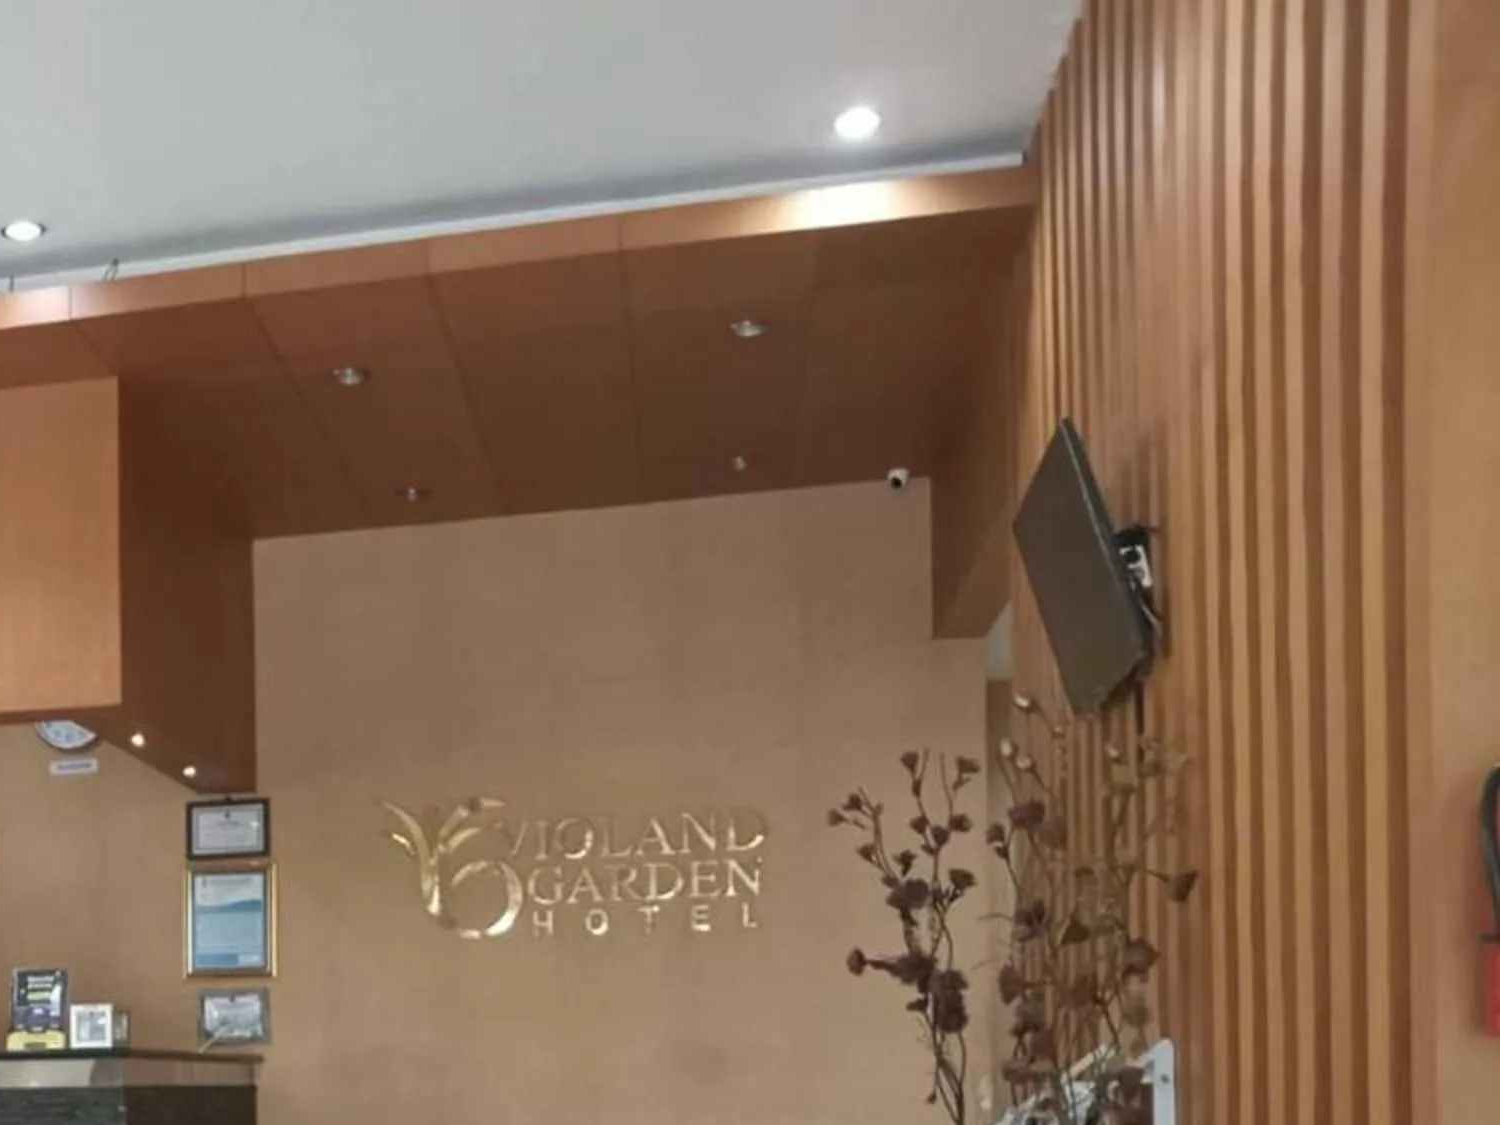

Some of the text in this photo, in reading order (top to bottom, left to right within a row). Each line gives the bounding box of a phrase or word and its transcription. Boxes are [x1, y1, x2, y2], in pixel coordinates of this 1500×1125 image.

[495, 811, 767, 861] VIOLAND
[527, 857, 761, 904] GARDEN
[532, 901, 758, 936] HOTEL
